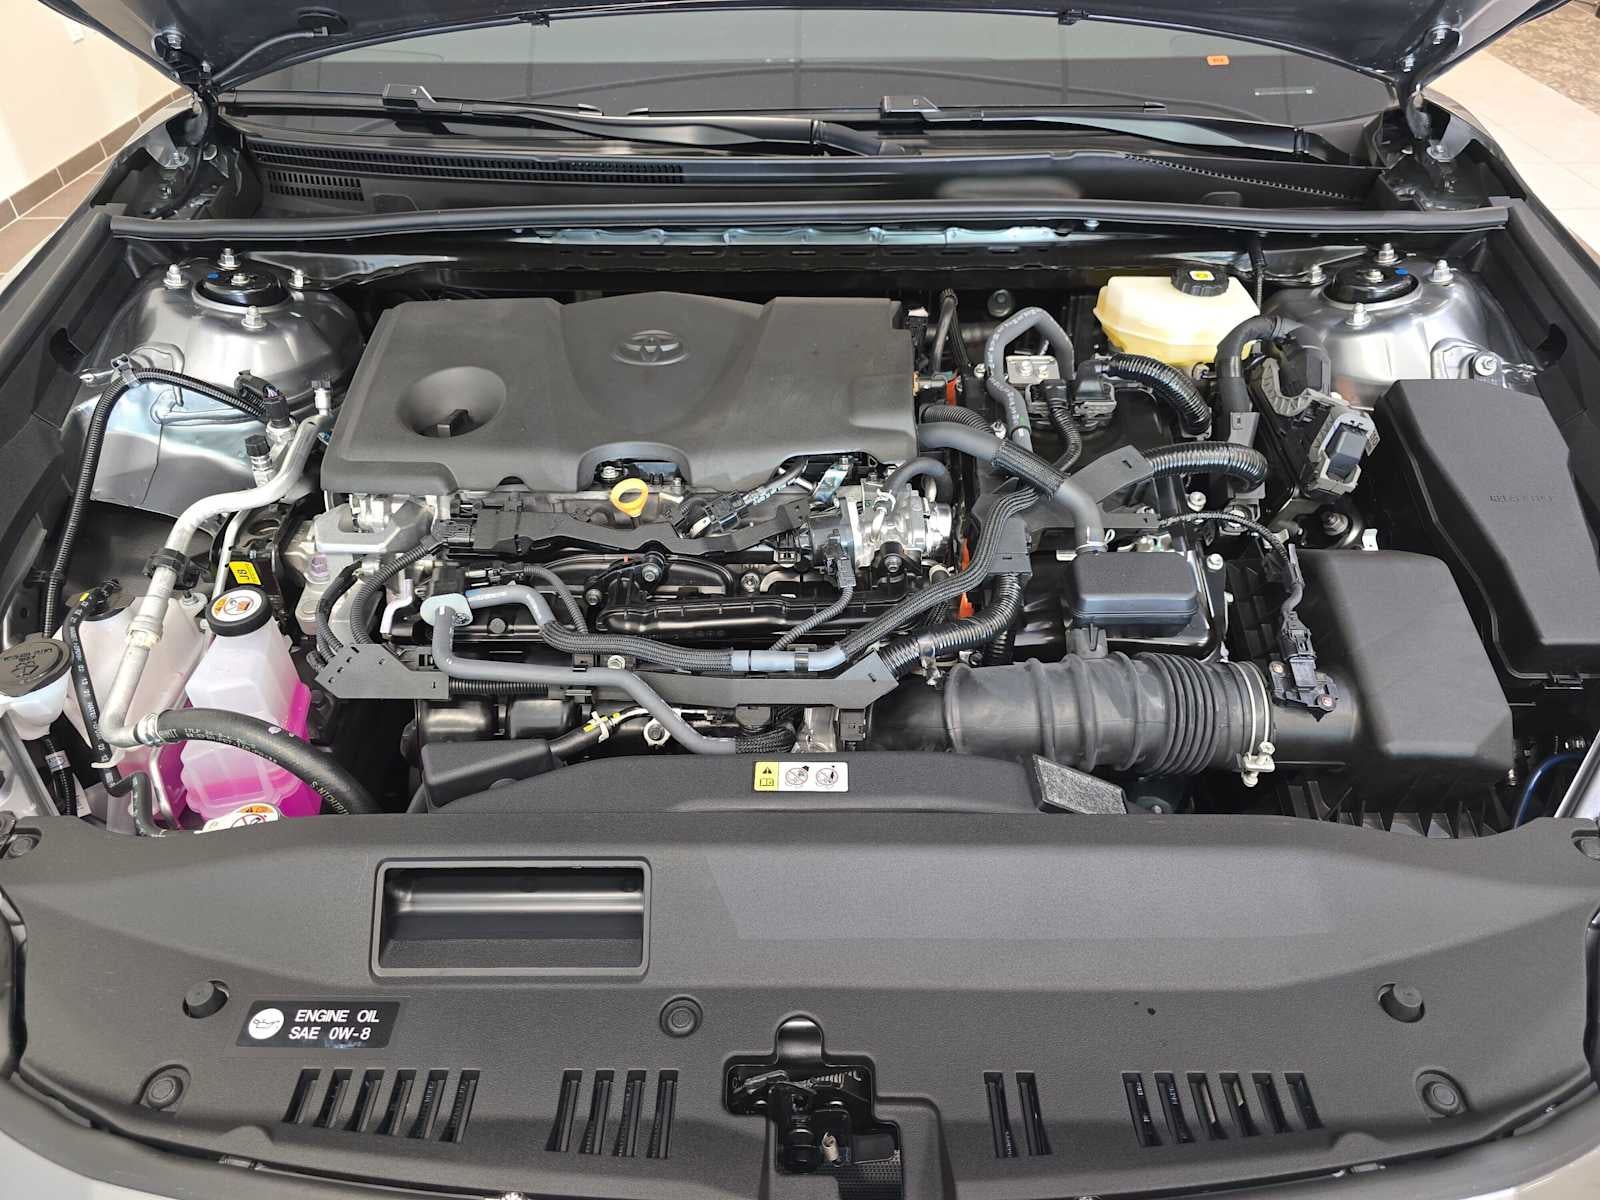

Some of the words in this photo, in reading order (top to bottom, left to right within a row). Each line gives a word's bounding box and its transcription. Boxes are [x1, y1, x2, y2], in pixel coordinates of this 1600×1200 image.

[294, 1009, 350, 1022] ENGINE
[356, 1009, 380, 1022] OIL
[288, 1026, 321, 1040] SAE
[328, 1026, 371, 1041] 0W-8
